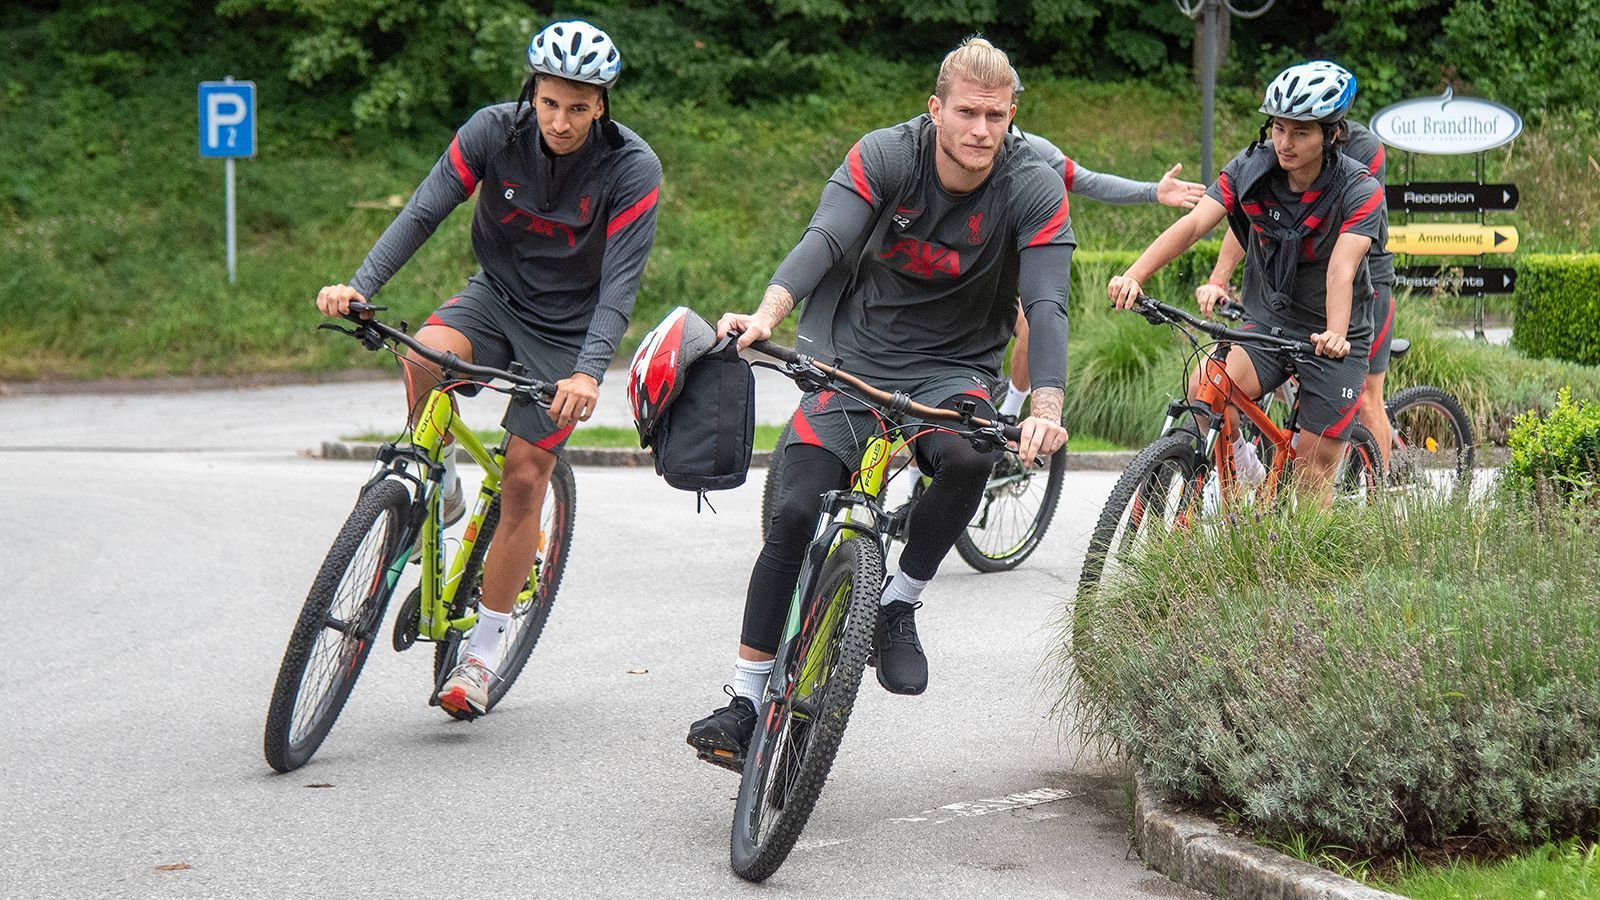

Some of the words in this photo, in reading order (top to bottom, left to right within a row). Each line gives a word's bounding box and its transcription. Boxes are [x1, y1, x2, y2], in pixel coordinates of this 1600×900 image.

[207, 92, 247, 149] P
[1391, 116, 1416, 135] Gut
[1423, 115, 1500, 135] Brandlhof
[226, 127, 237, 148] 2
[504, 188, 515, 200] 6
[1403, 191, 1475, 205] Reception
[1268, 209, 1281, 221] 18
[1418, 233, 1484, 245] Anmeldung
[1341, 387, 1354, 399] 18
[864, 442, 881, 487] FOCUS
